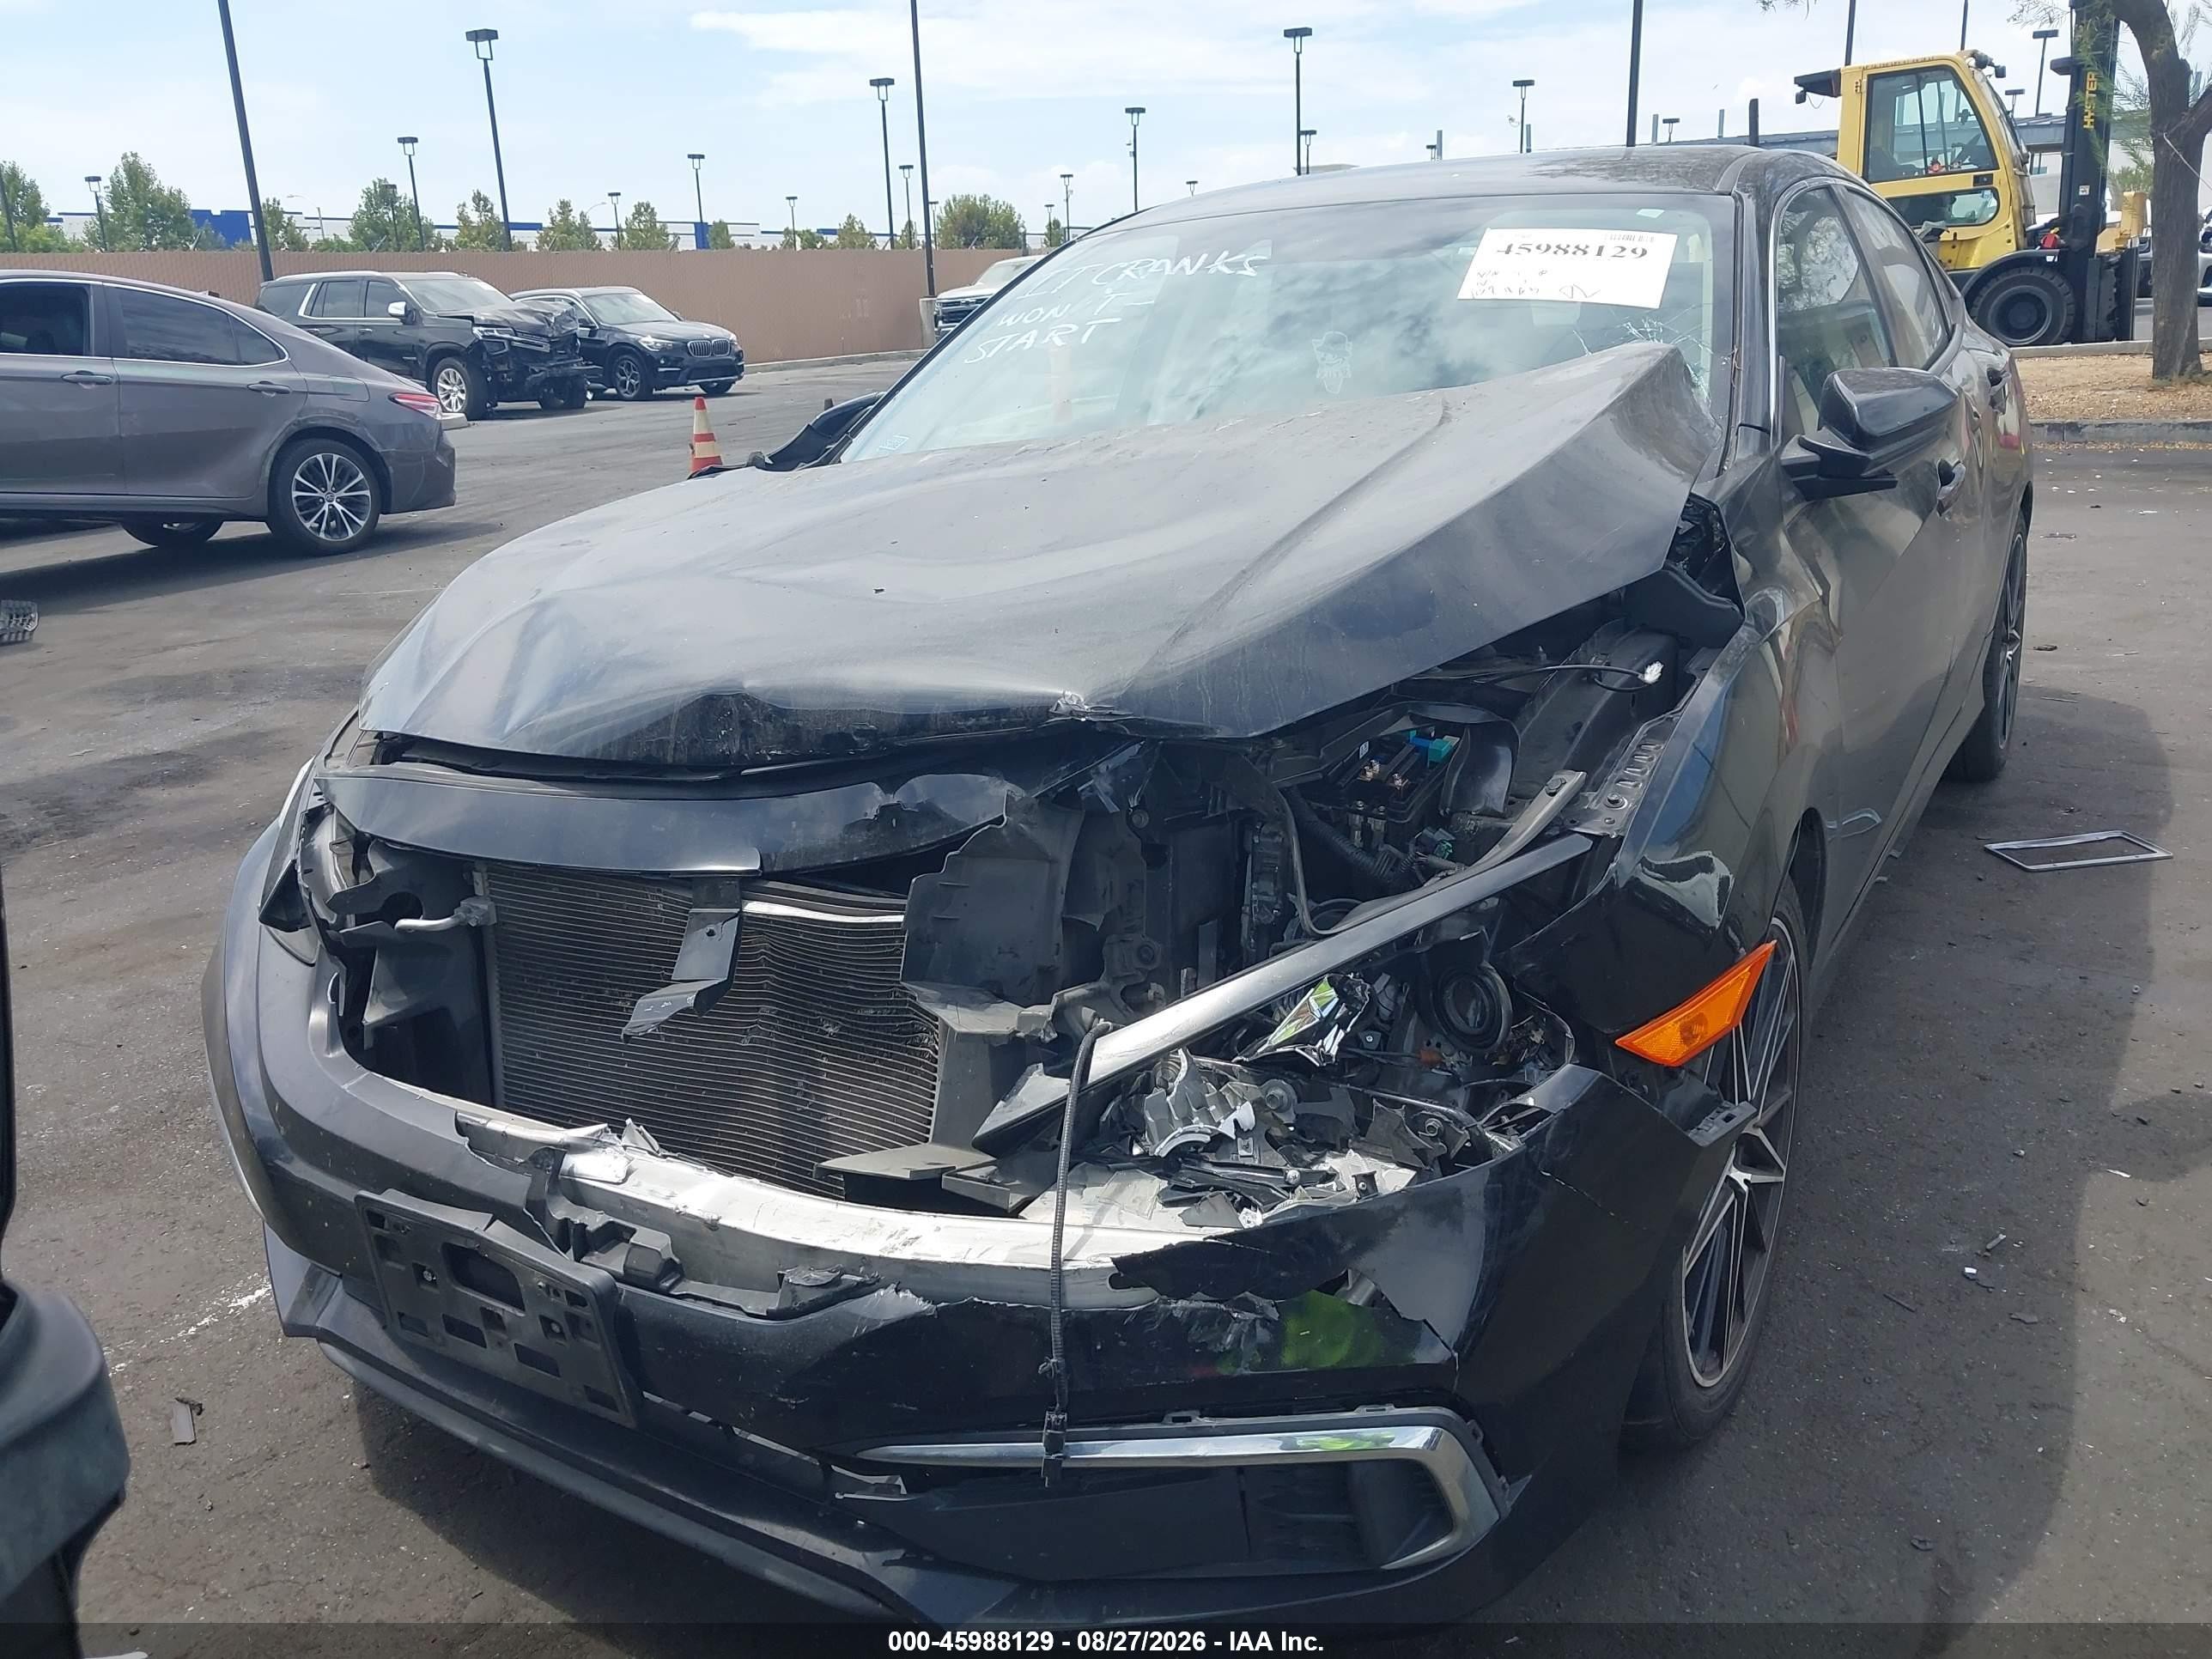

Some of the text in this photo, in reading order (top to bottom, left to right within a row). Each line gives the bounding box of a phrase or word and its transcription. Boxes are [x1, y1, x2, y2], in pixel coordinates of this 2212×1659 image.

[2082, 71, 2099, 129] HYSTER
[1497, 242, 1648, 258] 45988129
[1016, 250, 1271, 300] IT CRANKS
[963, 318, 1122, 364] START
